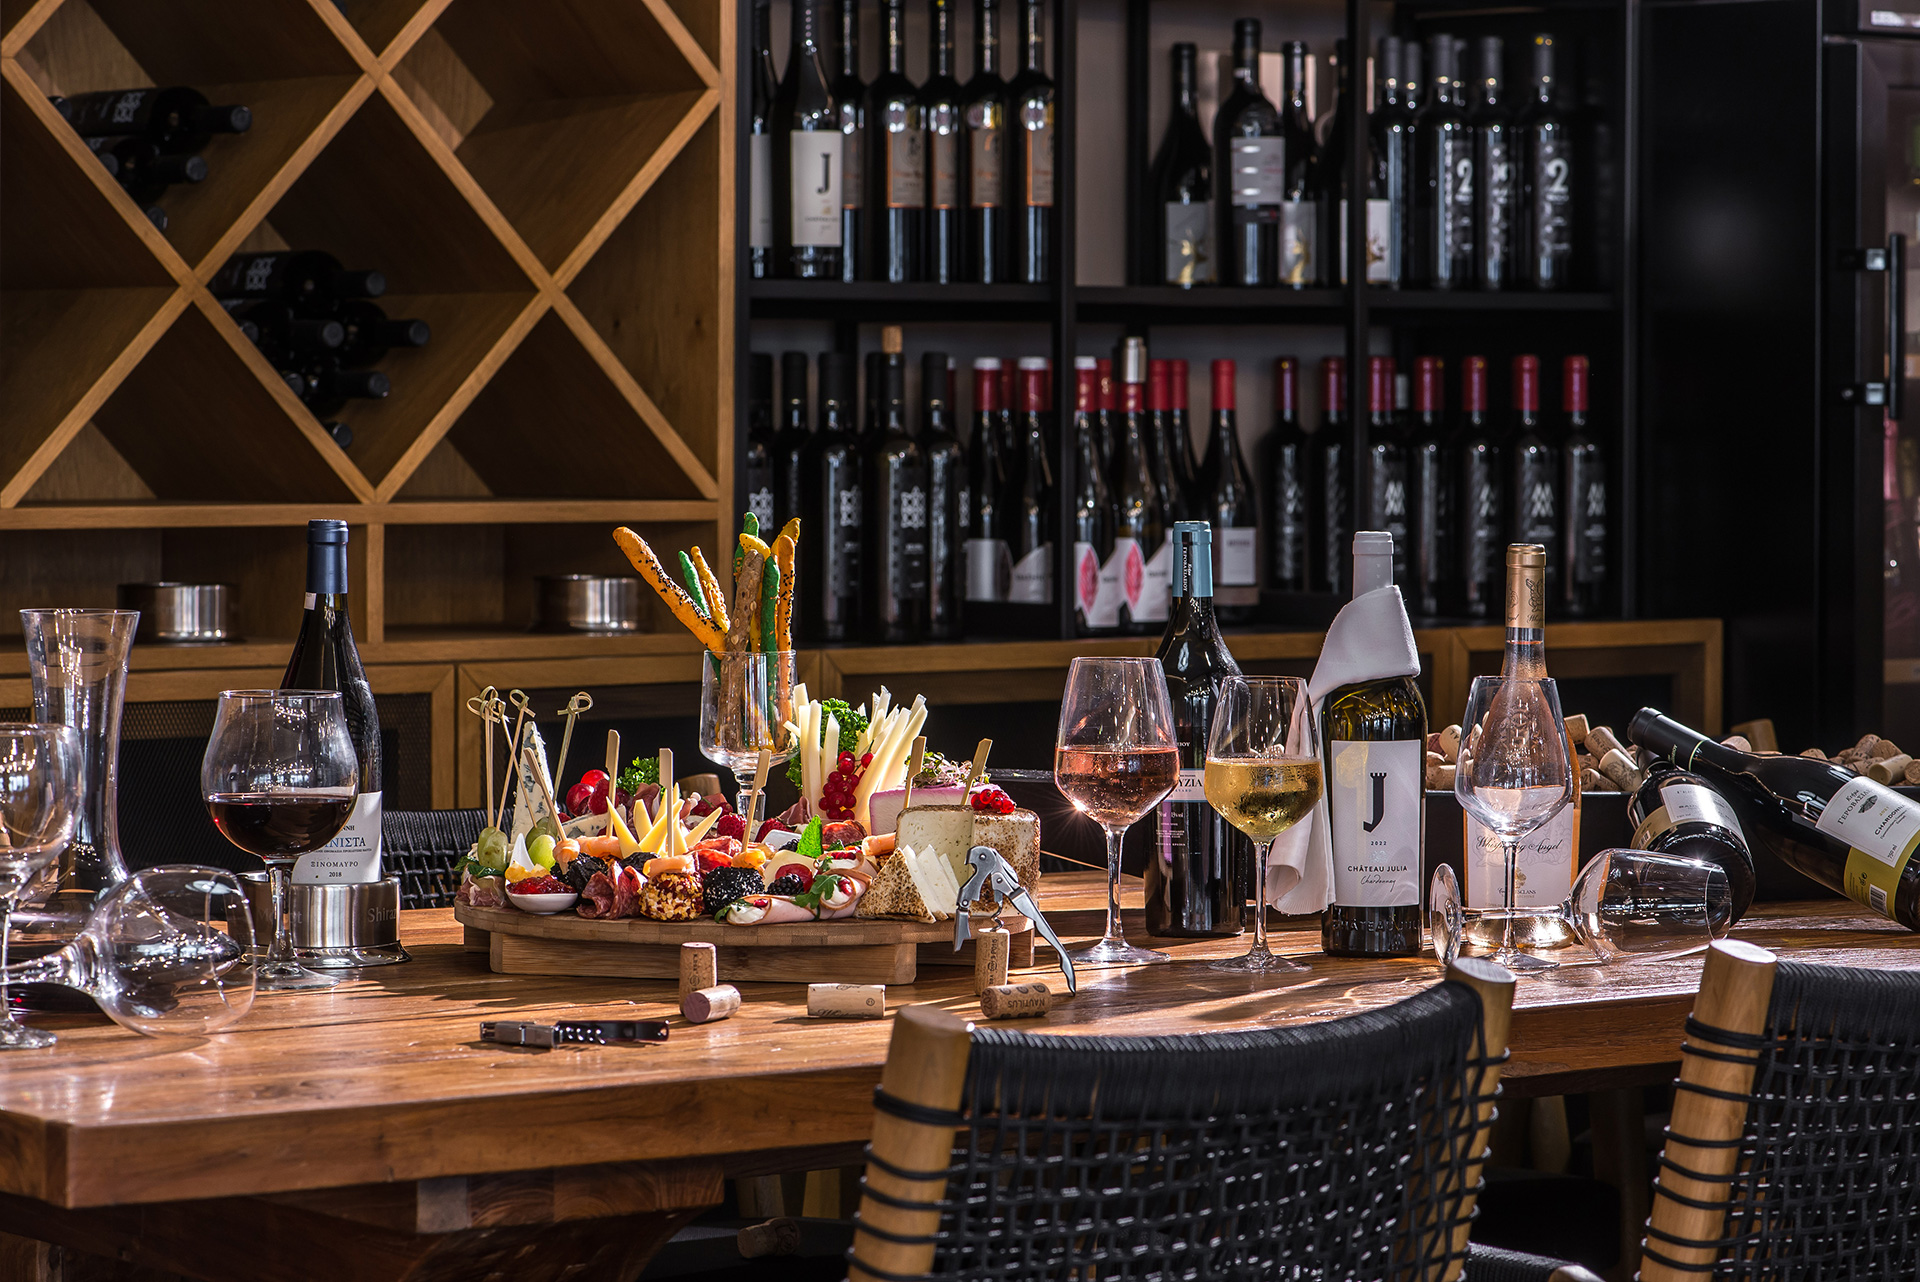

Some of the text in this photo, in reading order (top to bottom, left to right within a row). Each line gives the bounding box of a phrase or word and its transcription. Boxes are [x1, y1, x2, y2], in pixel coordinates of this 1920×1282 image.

[816, 153, 831, 194] J
[1362, 772, 1387, 833] J
[1528, 837, 1563, 854] Angel
[1360, 874, 1397, 892] Chardonnay
[1007, 998, 1046, 1010] NAUTILUS
